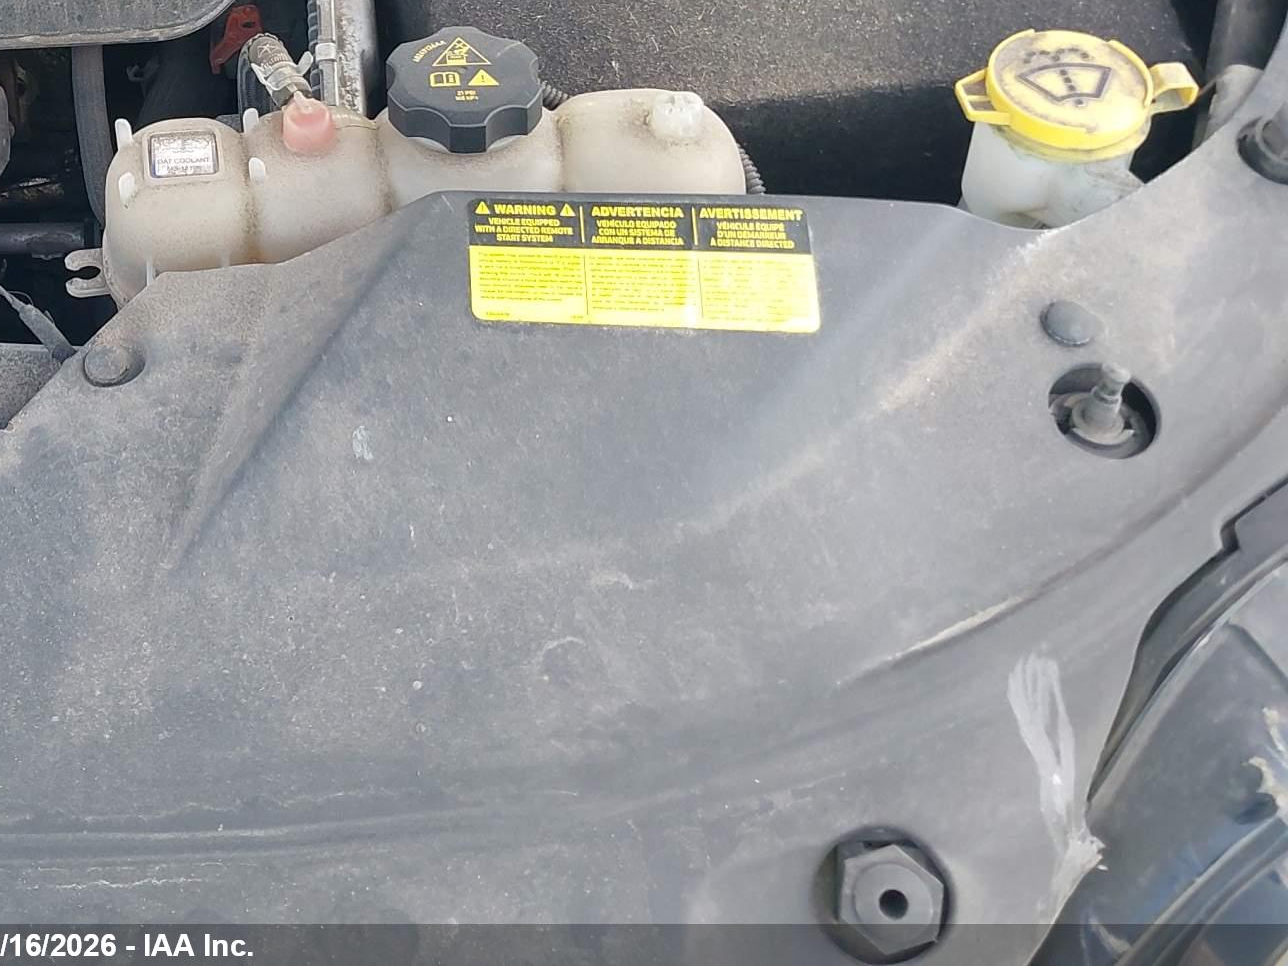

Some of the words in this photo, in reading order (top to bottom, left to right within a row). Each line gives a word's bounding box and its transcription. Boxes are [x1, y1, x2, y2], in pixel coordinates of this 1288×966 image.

[493, 203, 557, 216] WARNING
[591, 205, 685, 218] ADVERTENCIA
[699, 207, 803, 221] AVERTISSEMENT
[488, 217, 520, 226] VEHICLE
[521, 218, 561, 227] EQUIPPED
[636, 220, 677, 229] EQUIPADO
[475, 224, 495, 233] WITH
[496, 225, 502, 233] A
[503, 226, 540, 234] DIRECTED
[541, 227, 574, 235] REMOTE
[598, 228, 616, 236] CON
[616, 228, 628, 236] UN
[628, 228, 663, 237] SISTEMA
[664, 229, 676, 237] DE
[496, 233, 521, 242] START
[521, 234, 553, 243] SYSTEM
[591, 236, 635, 245] ARRANQUE
[635, 237, 642, 245] A
[642, 237, 684, 246] DISTANCIA
[717, 238, 755, 248] DISTANCE
[756, 240, 795, 249] DIRECTED
